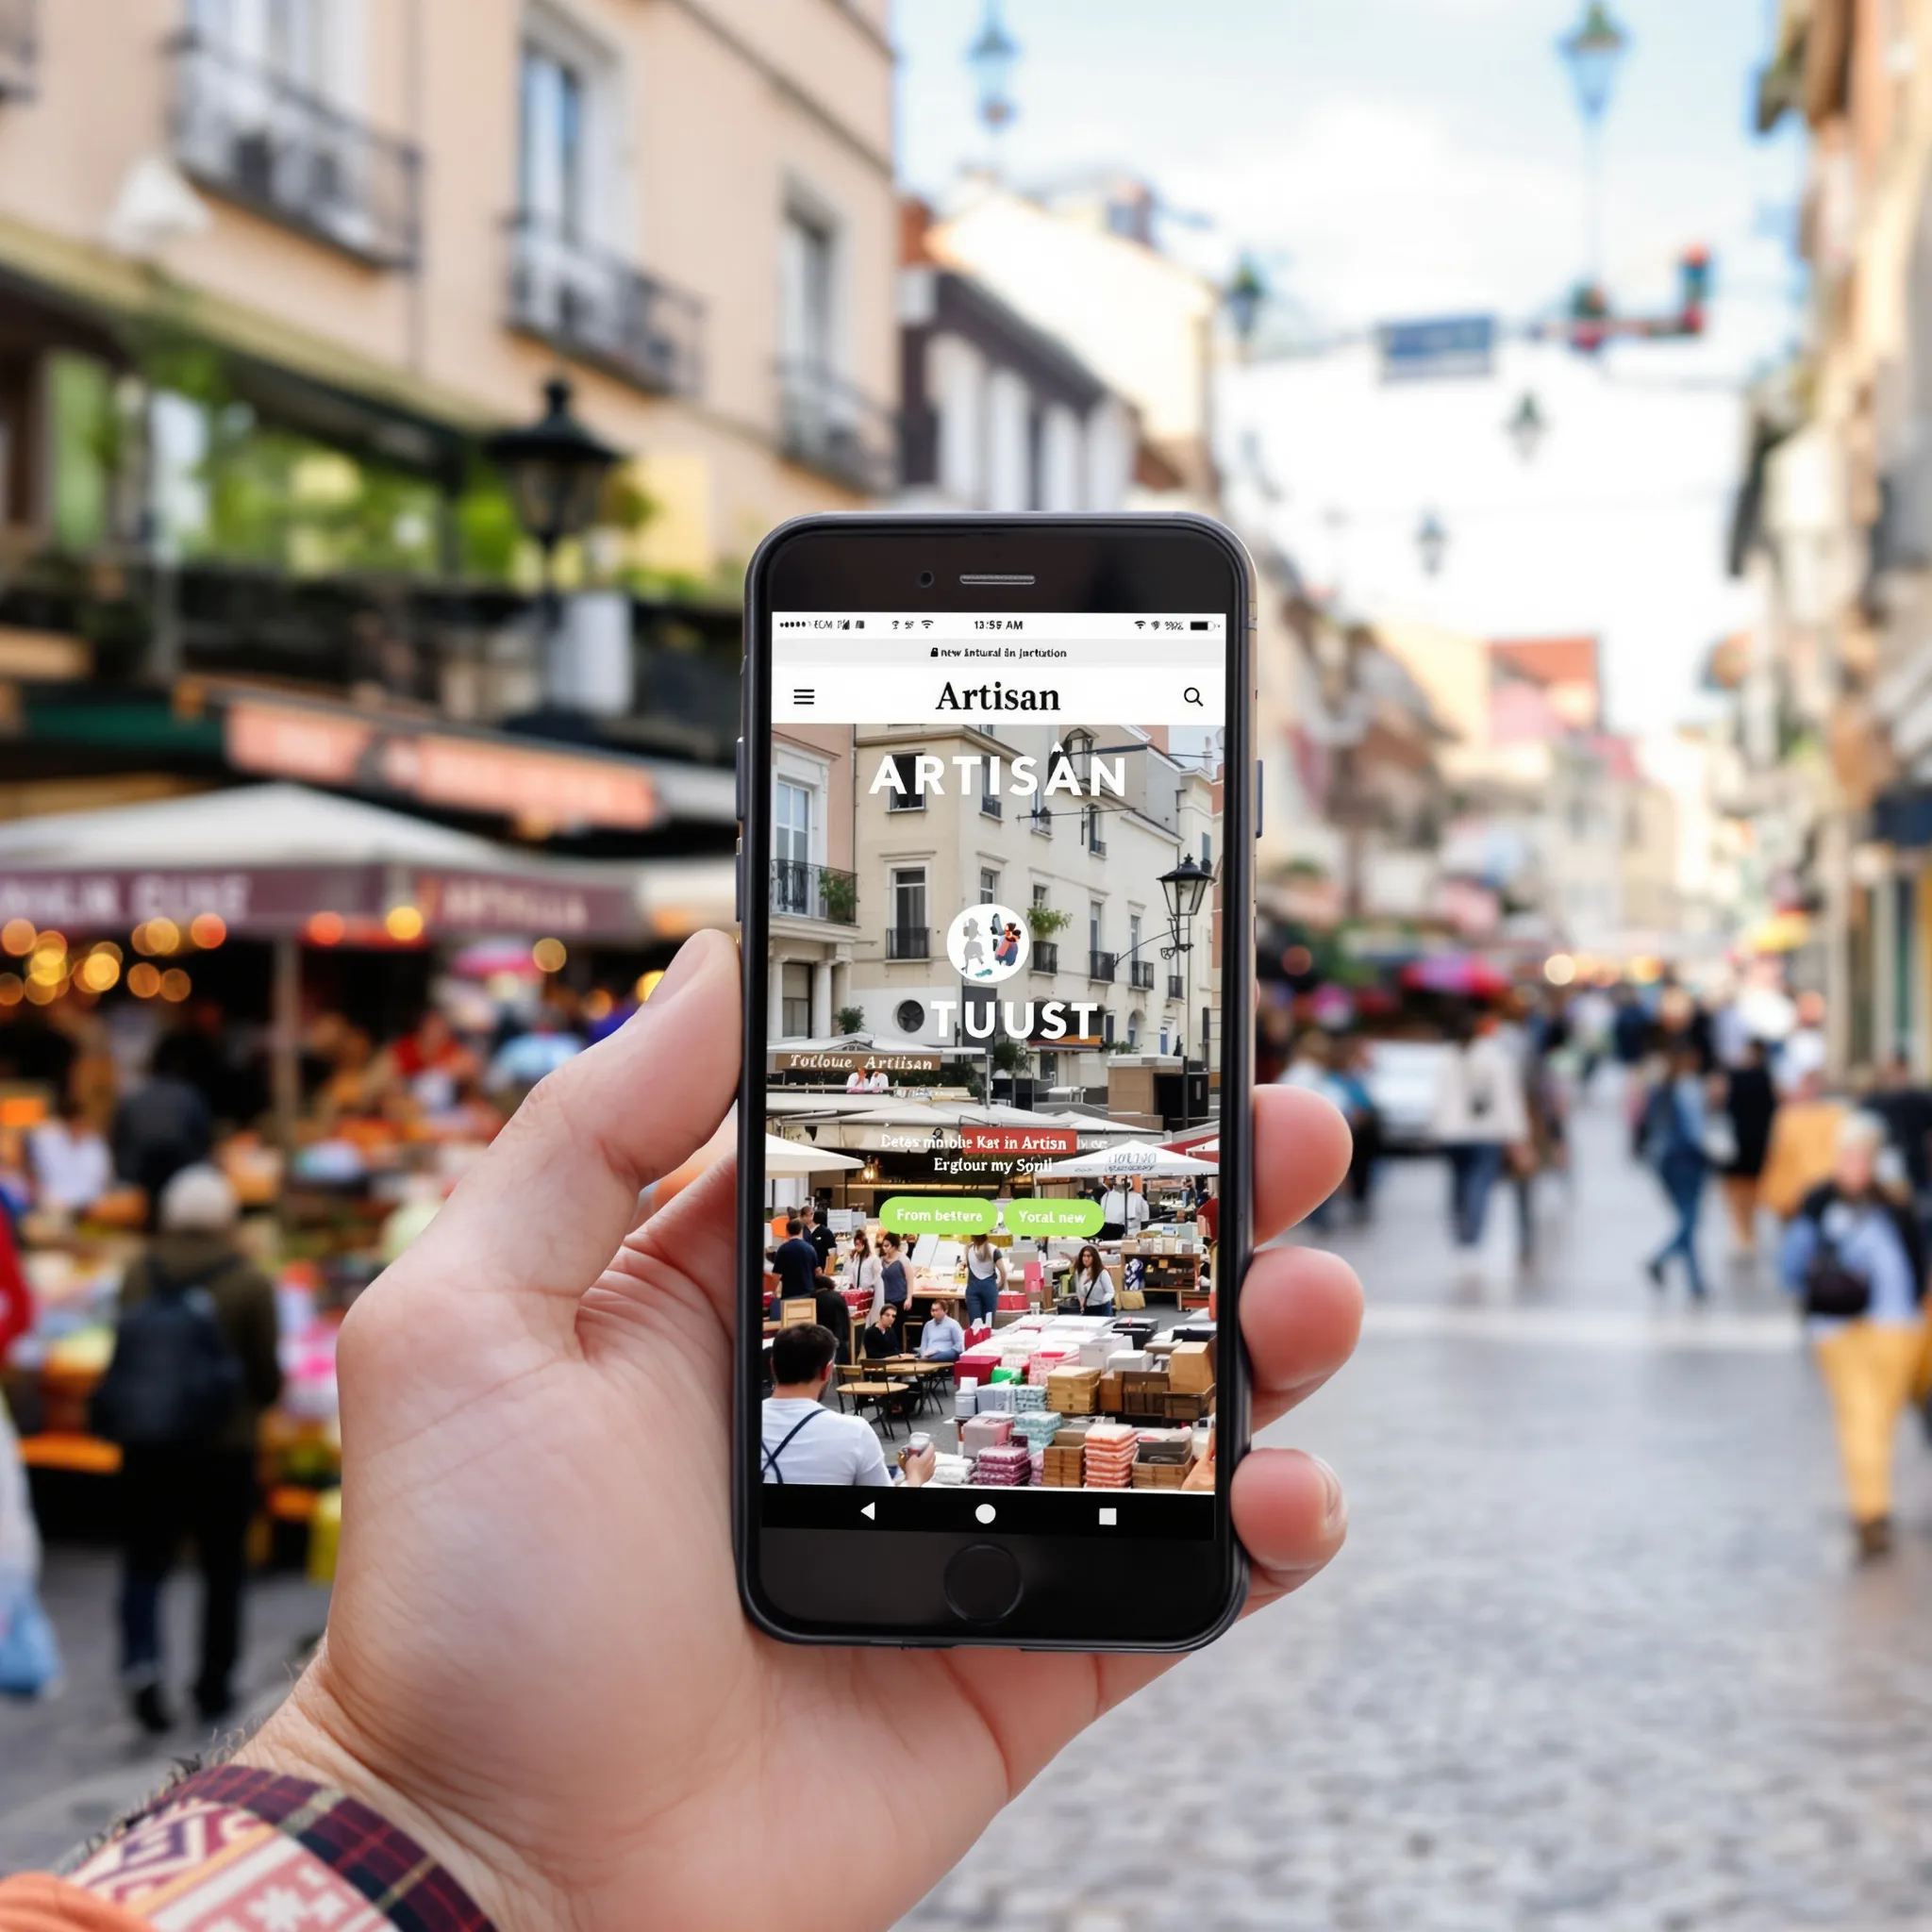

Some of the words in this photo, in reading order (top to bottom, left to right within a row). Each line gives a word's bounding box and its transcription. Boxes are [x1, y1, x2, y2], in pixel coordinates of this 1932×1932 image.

[1006, 620, 1024, 630] AM
[935, 681, 1061, 711] Artisan
[930, 1001, 1098, 1040] TUUST
[1004, 1136, 1018, 1150] in
[991, 1161, 1013, 1174] my
[896, 1208, 931, 1222] From
[1058, 1213, 1087, 1224] new
